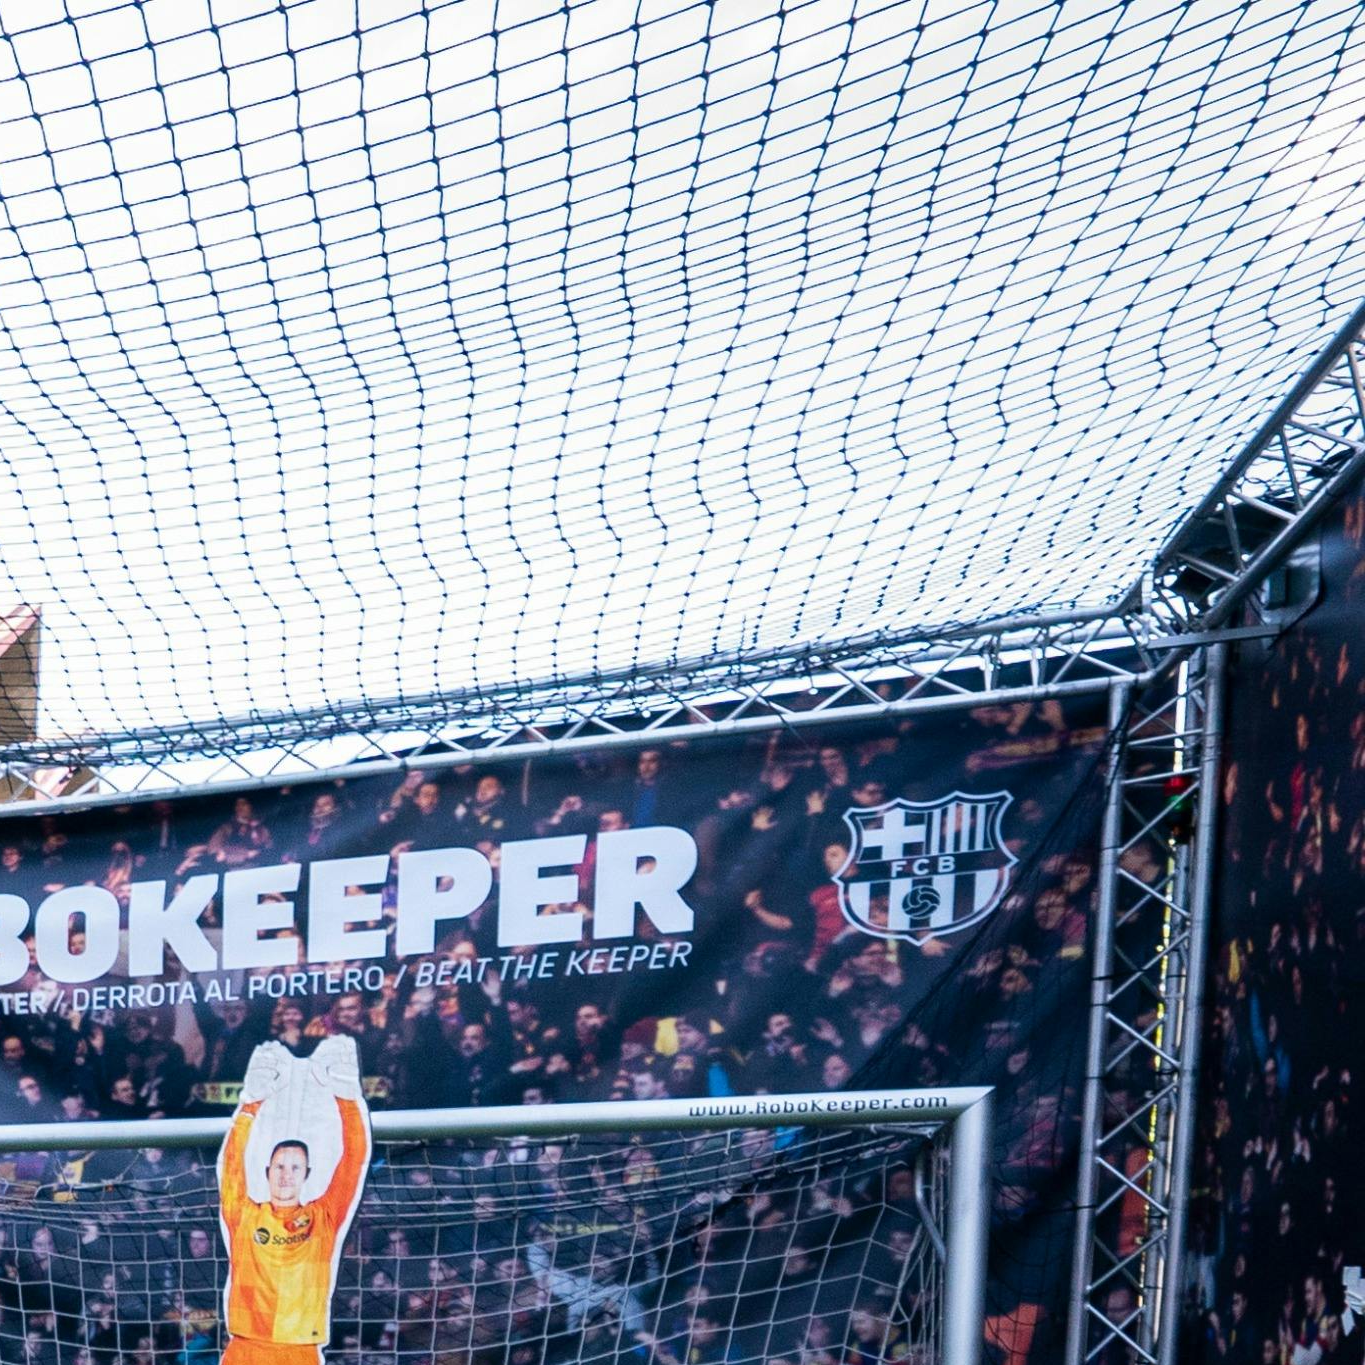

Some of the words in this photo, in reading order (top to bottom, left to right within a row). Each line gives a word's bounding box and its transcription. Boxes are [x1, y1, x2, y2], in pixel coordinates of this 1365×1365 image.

[891, 856, 955, 877] FCB
[73, 980, 195, 1012] DERROTA
[204, 976, 239, 1002] AL
[248, 965, 385, 999] PORTERO
[415, 957, 490, 988] BEAT
[499, 952, 560, 981] THE
[566, 942, 694, 976] KEEPER
[689, 1095, 948, 1117] www.RoboKeeper.com
